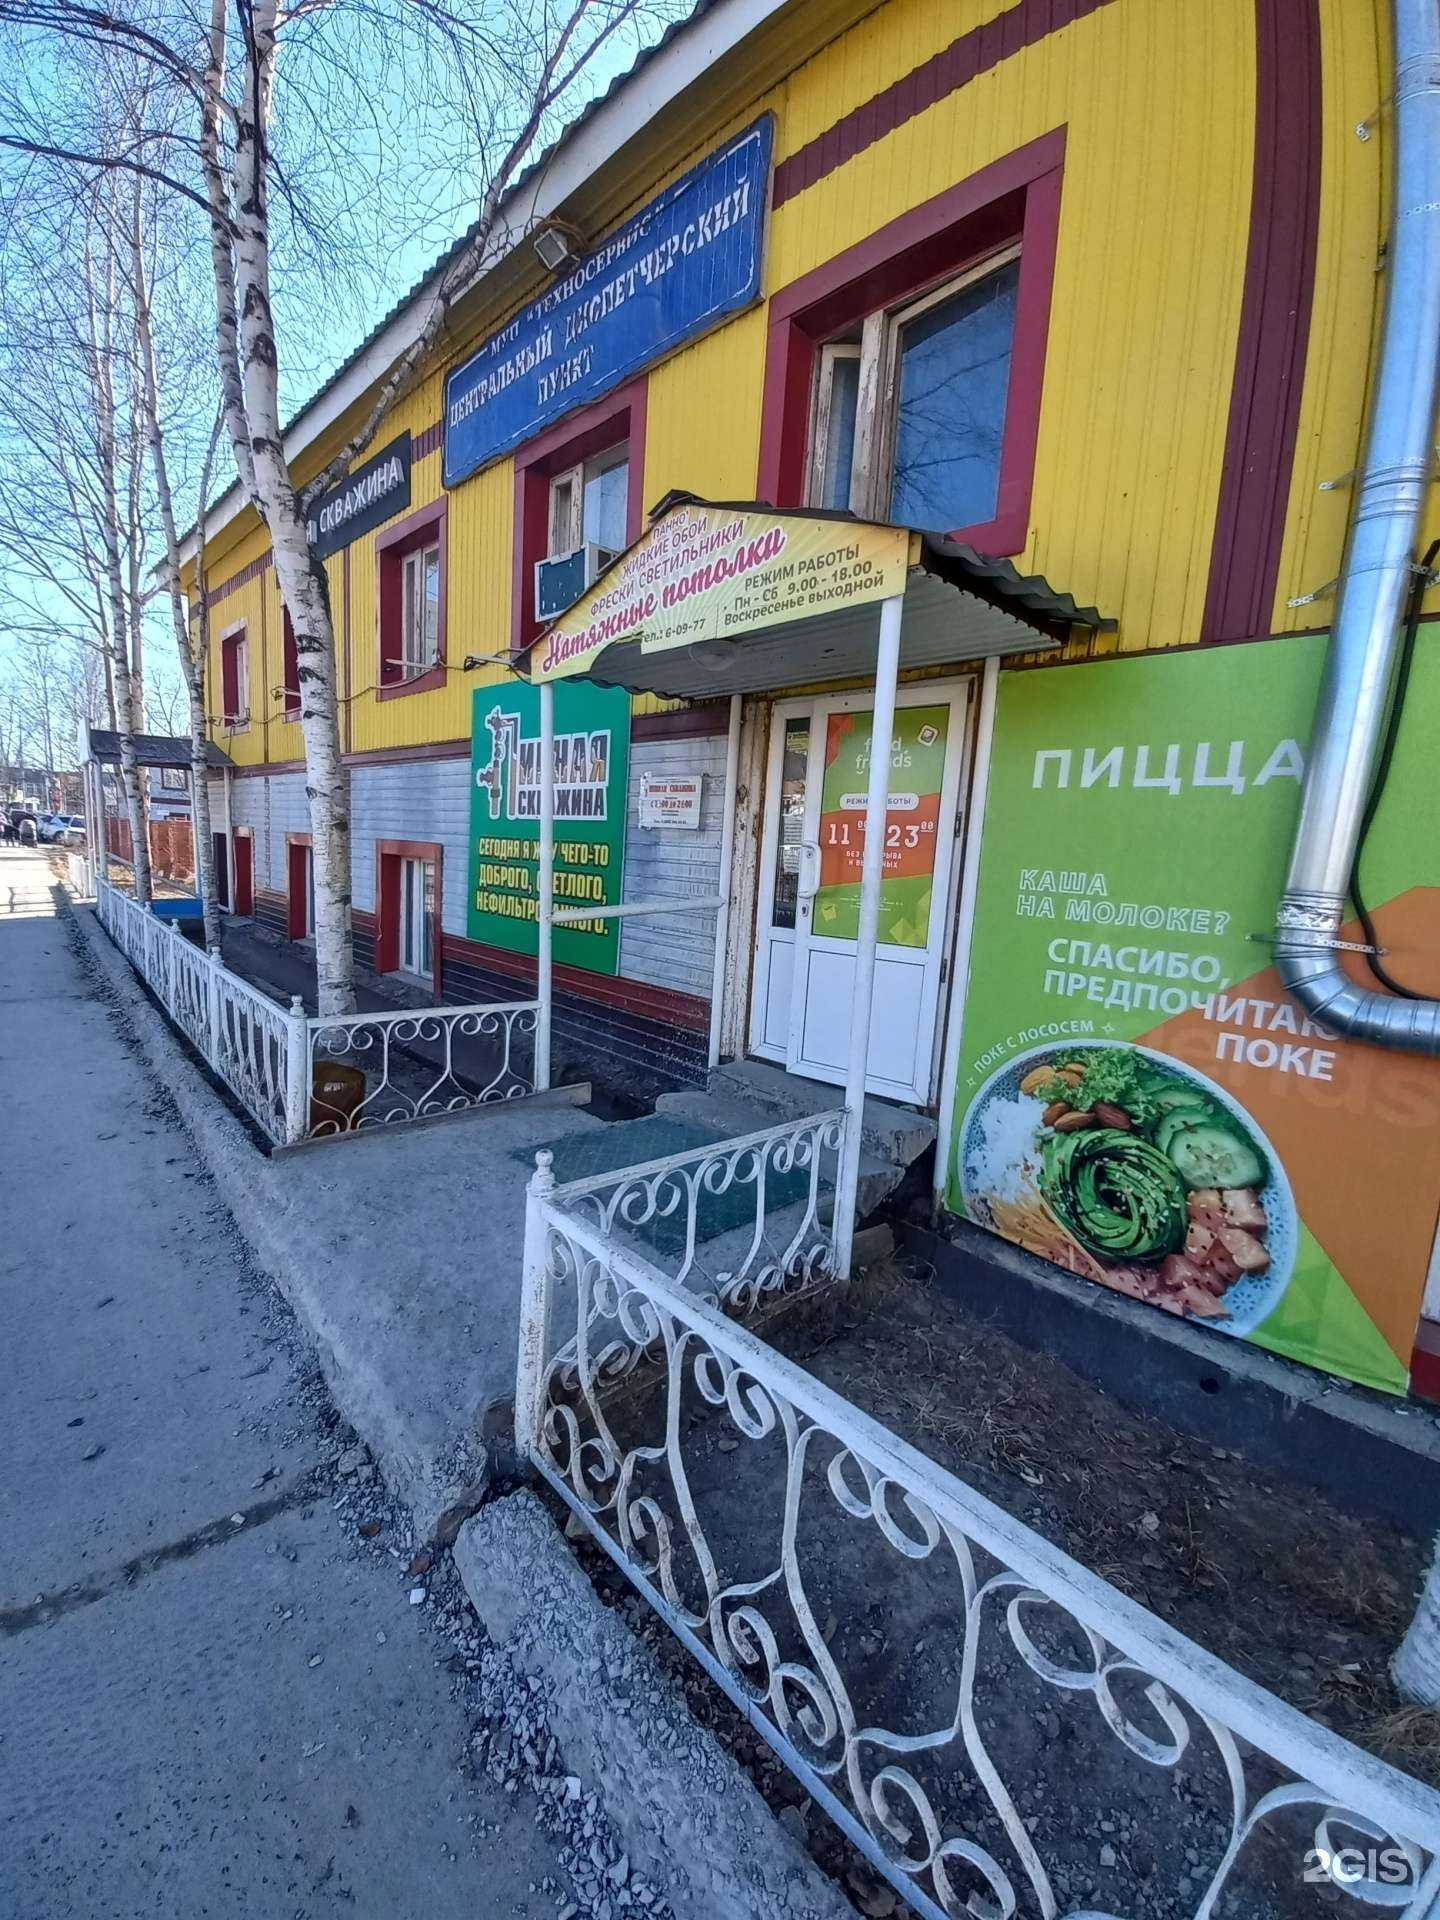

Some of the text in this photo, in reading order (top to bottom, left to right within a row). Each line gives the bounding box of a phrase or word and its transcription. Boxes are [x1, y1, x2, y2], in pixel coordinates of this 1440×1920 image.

[450, 174, 750, 429] ЦЕНТРАЛЬНЫЙ ДИСПЕТЧЕРСКИЙ
[537, 345, 594, 406] ПУНКТ
[319, 456, 405, 533] СКВАЖИНА
[623, 517, 707, 579] ЖИДКИЕ ОБОИ
[653, 514, 687, 540] ПАННО
[590, 519, 743, 617] ФРЕСКИ СВЕТИЛЬНИКИ
[734, 595, 750, 611] Пн
[762, 587, 778, 602] Сб
[787, 577, 817, 596] 9.00
[831, 560, 872, 584] 18.00
[744, 544, 859, 592] РЕЖИМ РАБОТЫ
[542, 528, 785, 672] Натяжные потолки
[724, 570, 884, 626] Воскресенье выходной
[665, 618, 706, 639] 6-09-77
[1032, 738, 1304, 796] ПИЦЦА
[518, 787, 605, 816] СКЖИНА
[479, 838, 520, 861] СЕГОДНЯ
[523, 841, 530, 859] Я
[561, 843, 609, 866] ЧЕГО-ТО
[829, 823, 850, 845] 11
[886, 825, 920, 848] 23
[479, 863, 533, 894] ДОБРОГО,
[1019, 868, 1108, 896] КАША
[1016, 895, 1231, 936] НА МОЛОКЕ?
[1047, 938, 1232, 988] СПАСИБО,
[974, 1020, 1094, 1074] ПОКЕ С ЛОСОСЕМ
[1215, 1032, 1337, 1081] ПОКЕ
